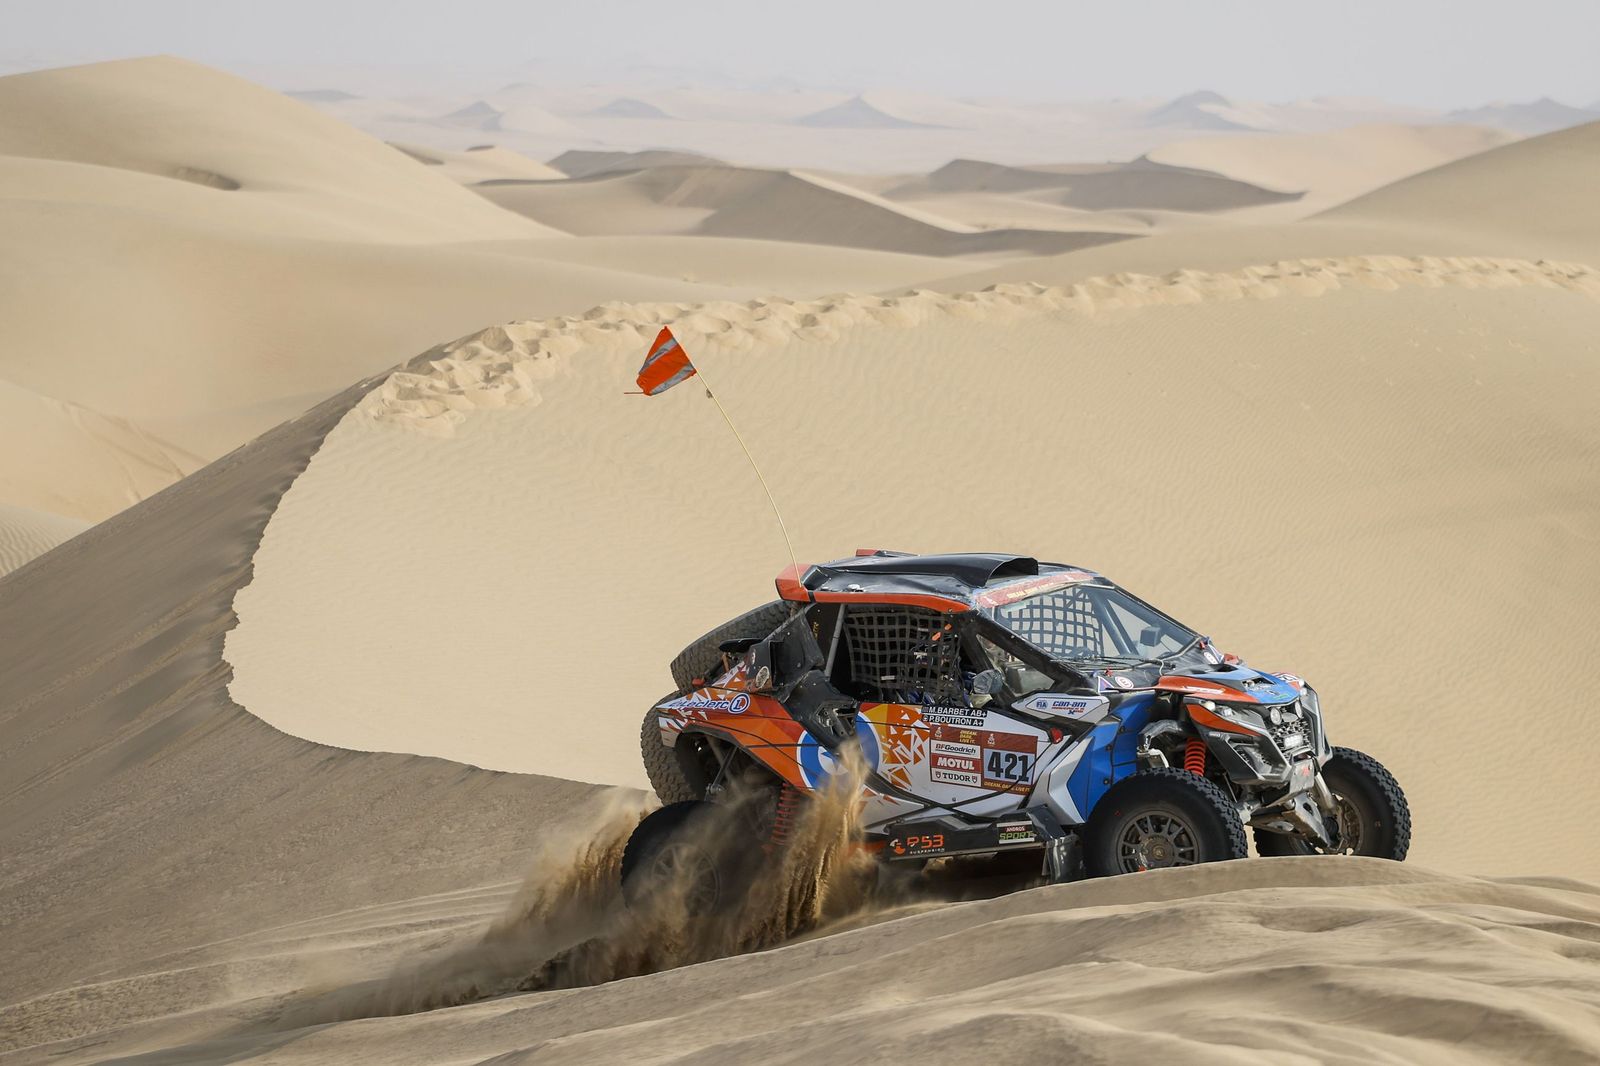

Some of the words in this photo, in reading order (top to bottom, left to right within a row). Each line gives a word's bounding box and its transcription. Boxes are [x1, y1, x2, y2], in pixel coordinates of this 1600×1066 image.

[929, 706, 970, 717] M.BARBET
[970, 709, 987, 718] AB+
[929, 715, 972, 725] P.BOUTRON
[935, 743, 976, 754] BFGoodrich
[937, 757, 975, 770] MOTUL
[987, 751, 1029, 782] 421
[942, 772, 971, 782] TUDOR
